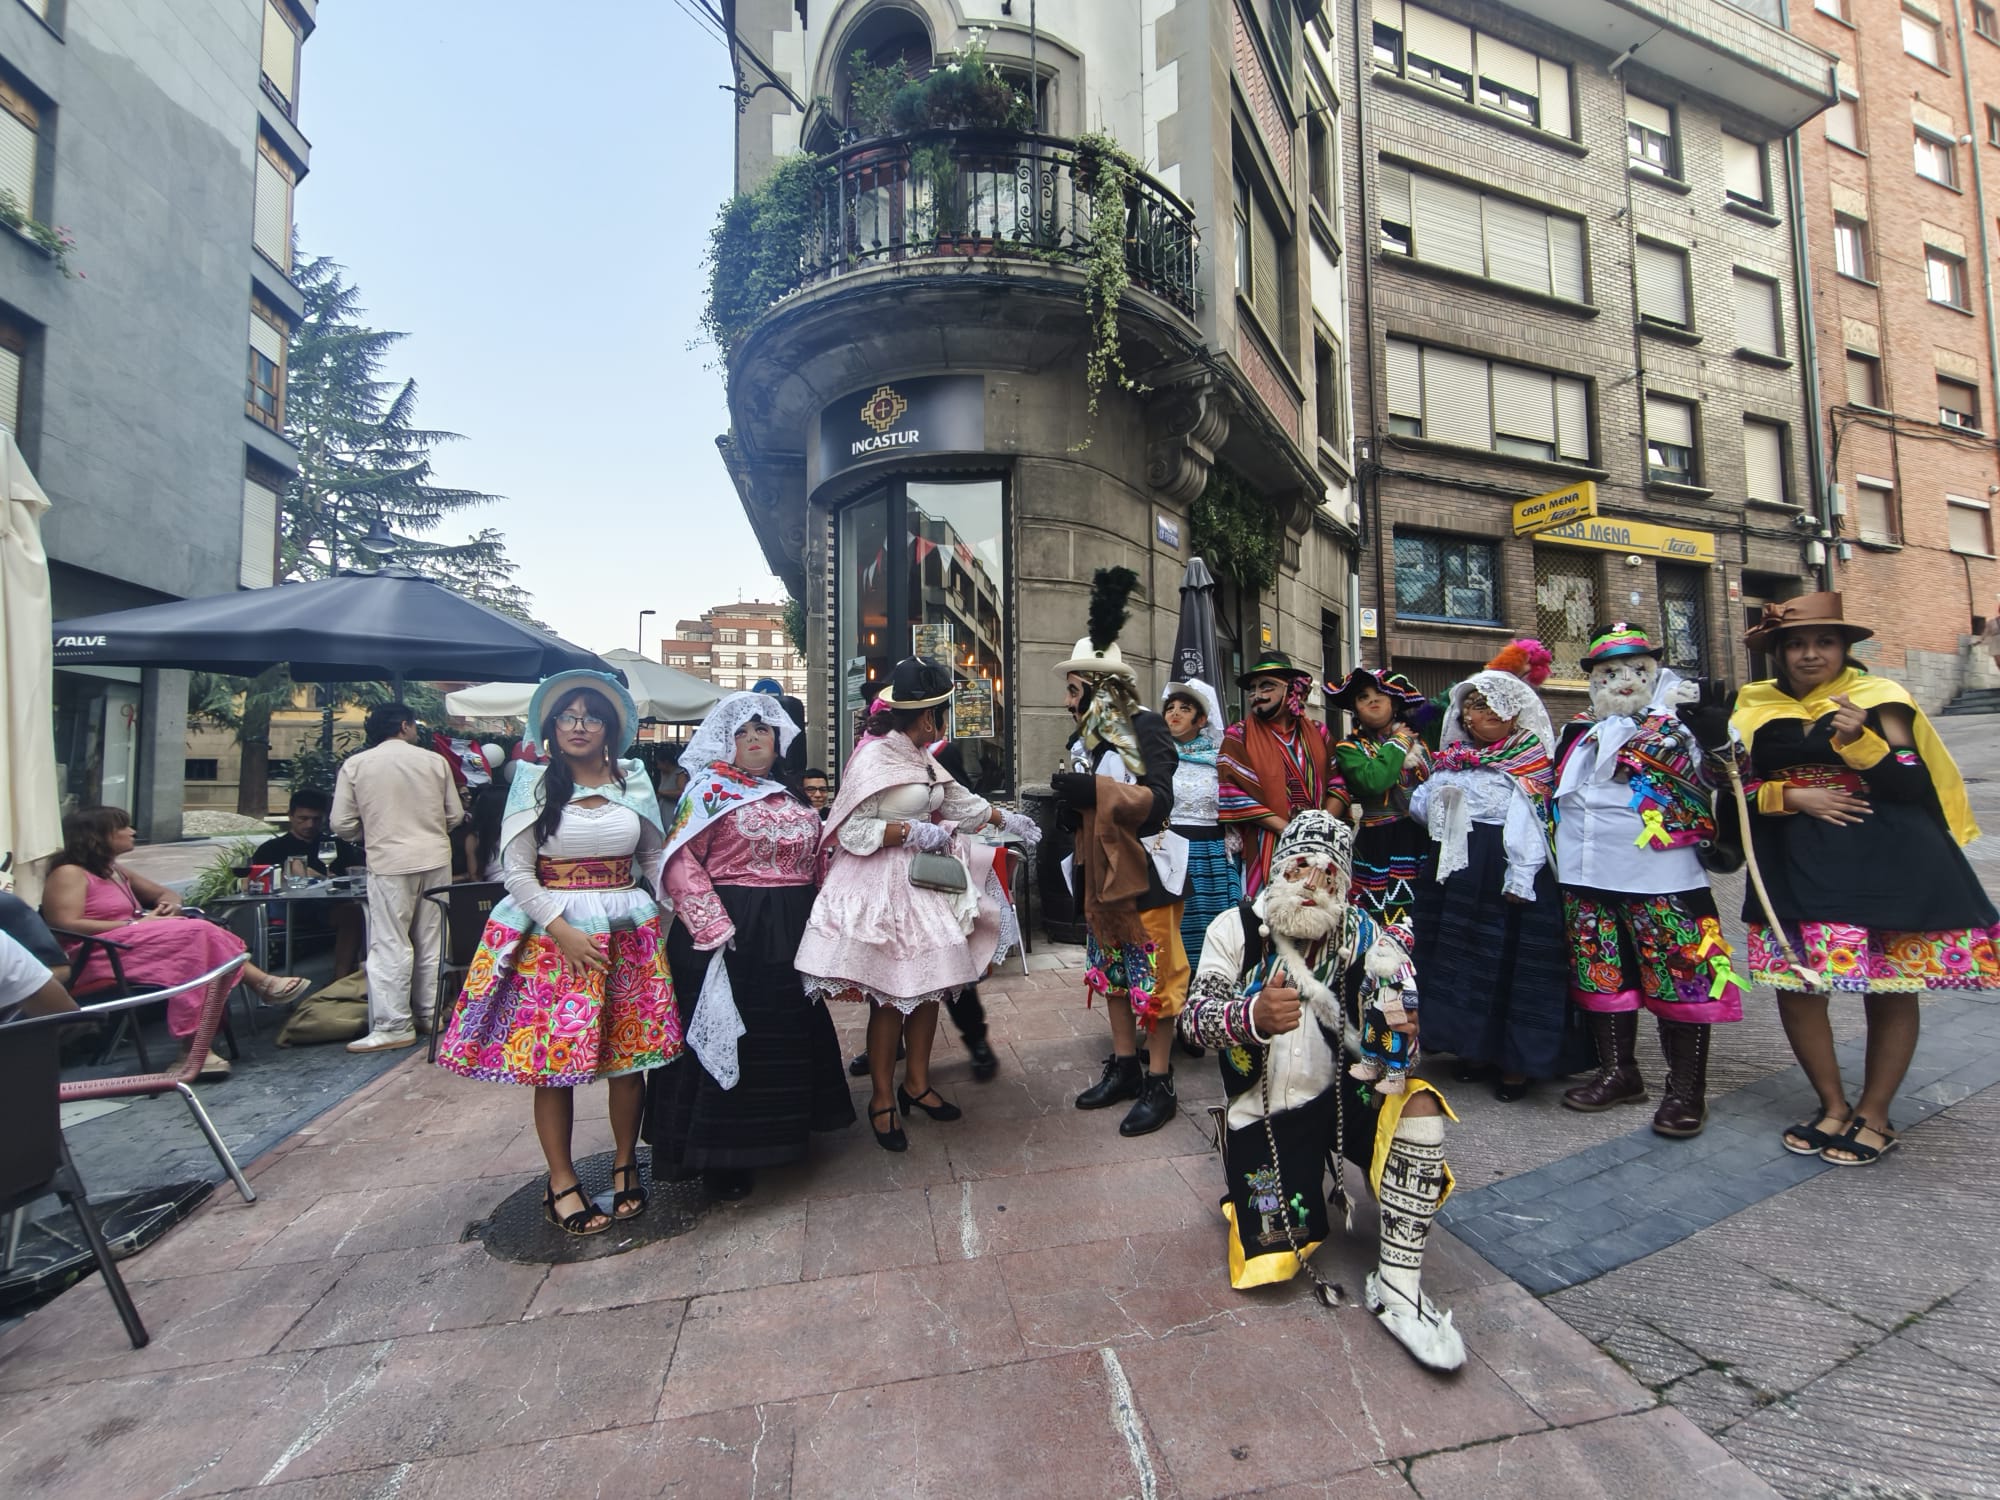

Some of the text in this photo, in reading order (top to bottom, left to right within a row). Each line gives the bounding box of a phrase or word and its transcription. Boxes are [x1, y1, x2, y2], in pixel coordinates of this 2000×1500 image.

[851, 430, 920, 455] INCASTUR
[1521, 492, 1580, 517] CASA MENA
[1591, 523, 1631, 545] MENA
